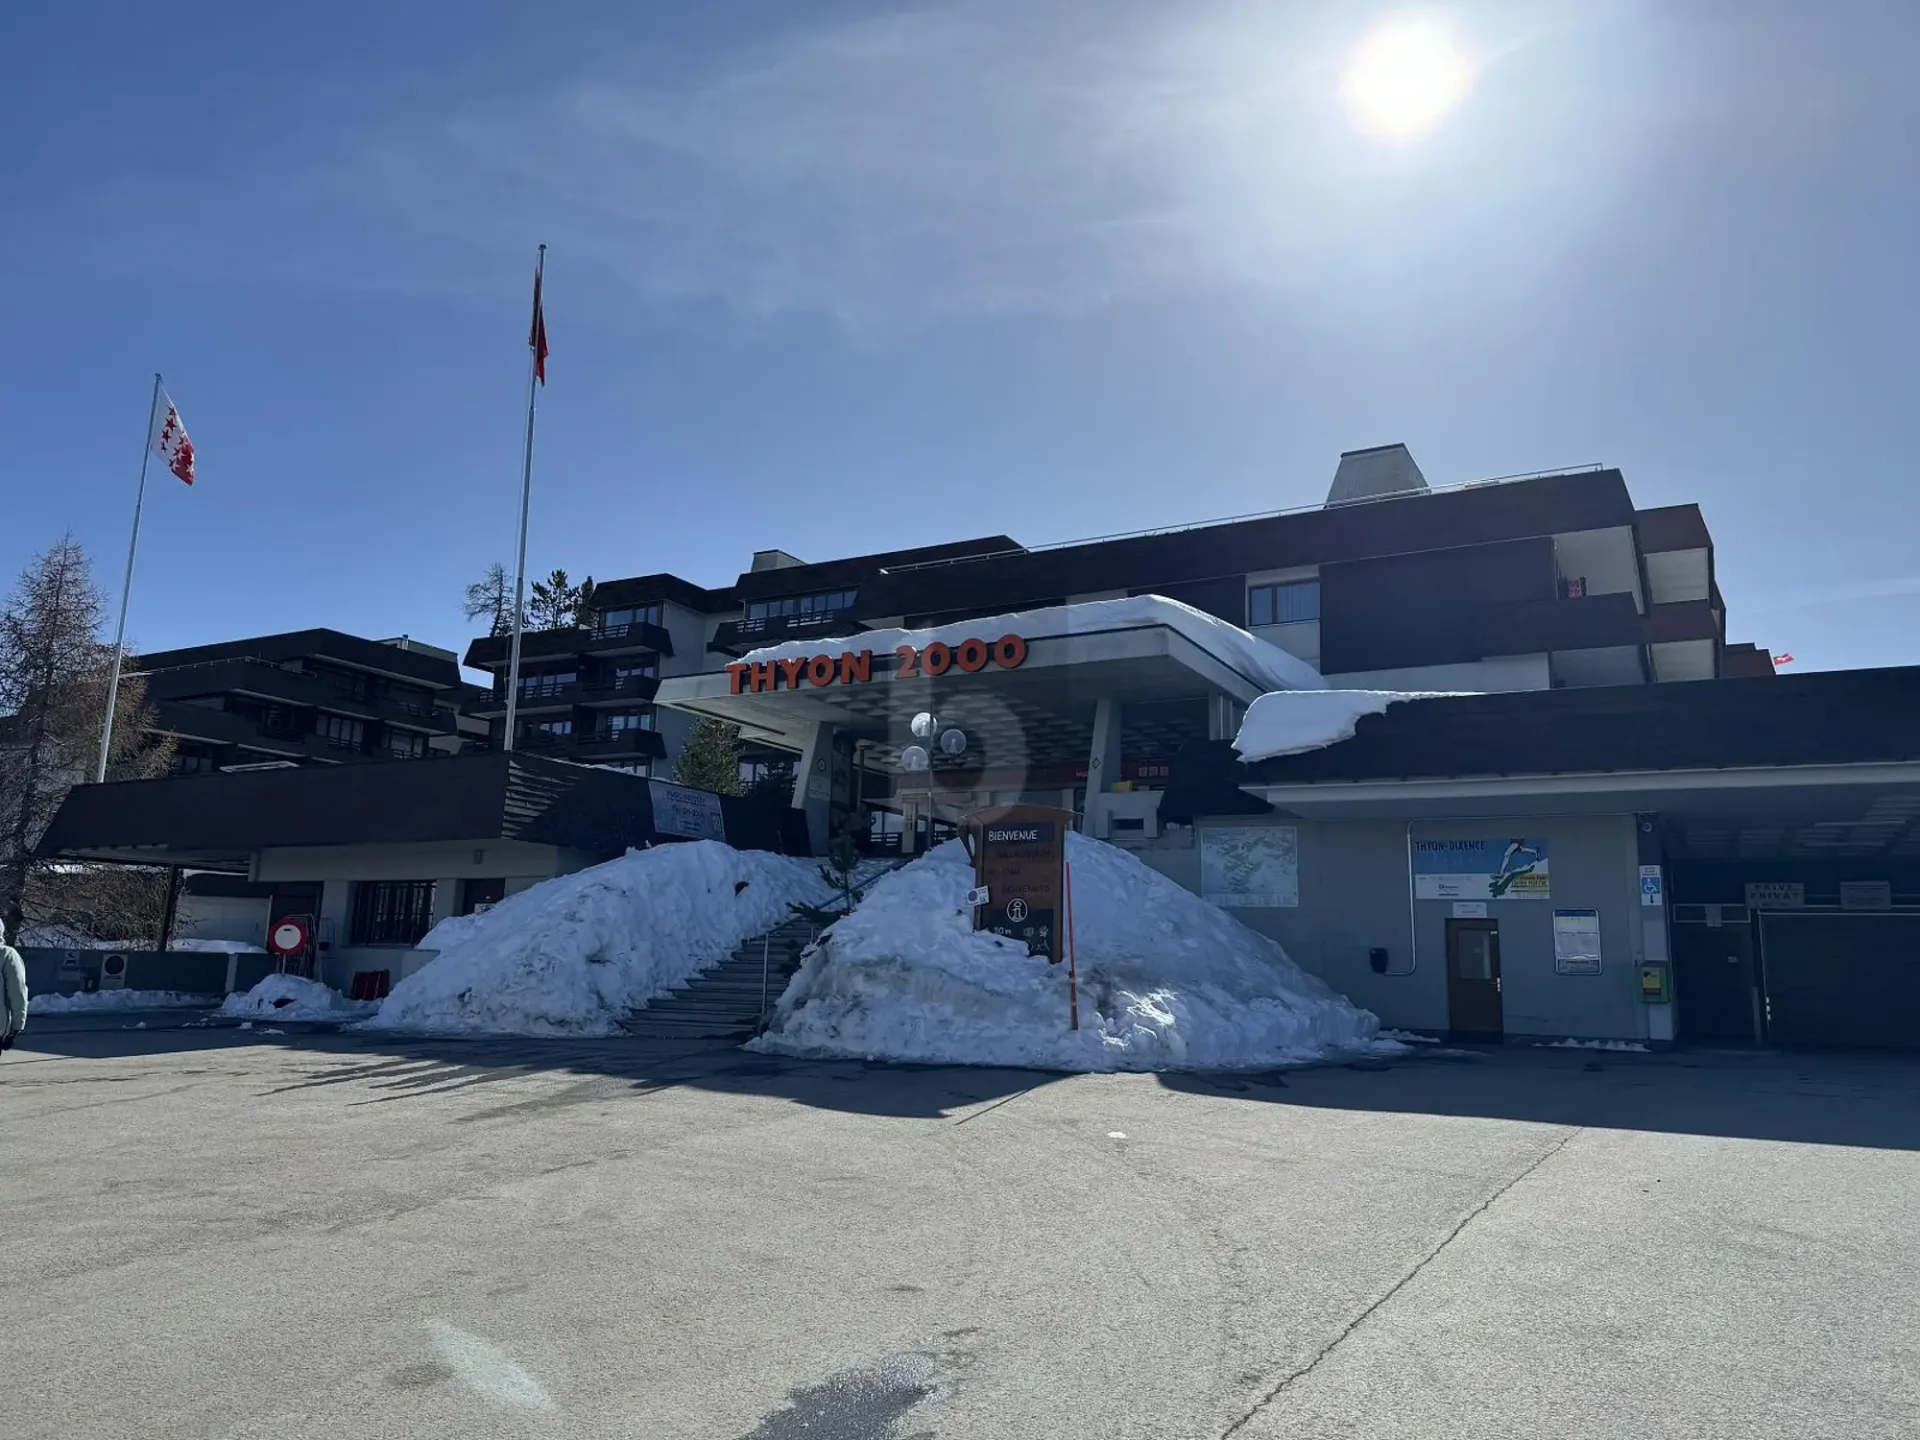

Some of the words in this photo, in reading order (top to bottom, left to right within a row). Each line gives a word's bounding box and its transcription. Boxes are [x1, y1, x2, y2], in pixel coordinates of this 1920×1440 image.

[726, 649, 871, 695] THYON
[894, 634, 1028, 679] 2000
[988, 829, 1038, 842] BIENVENUE
[1415, 840, 1485, 852] THYON-DIXENCE
